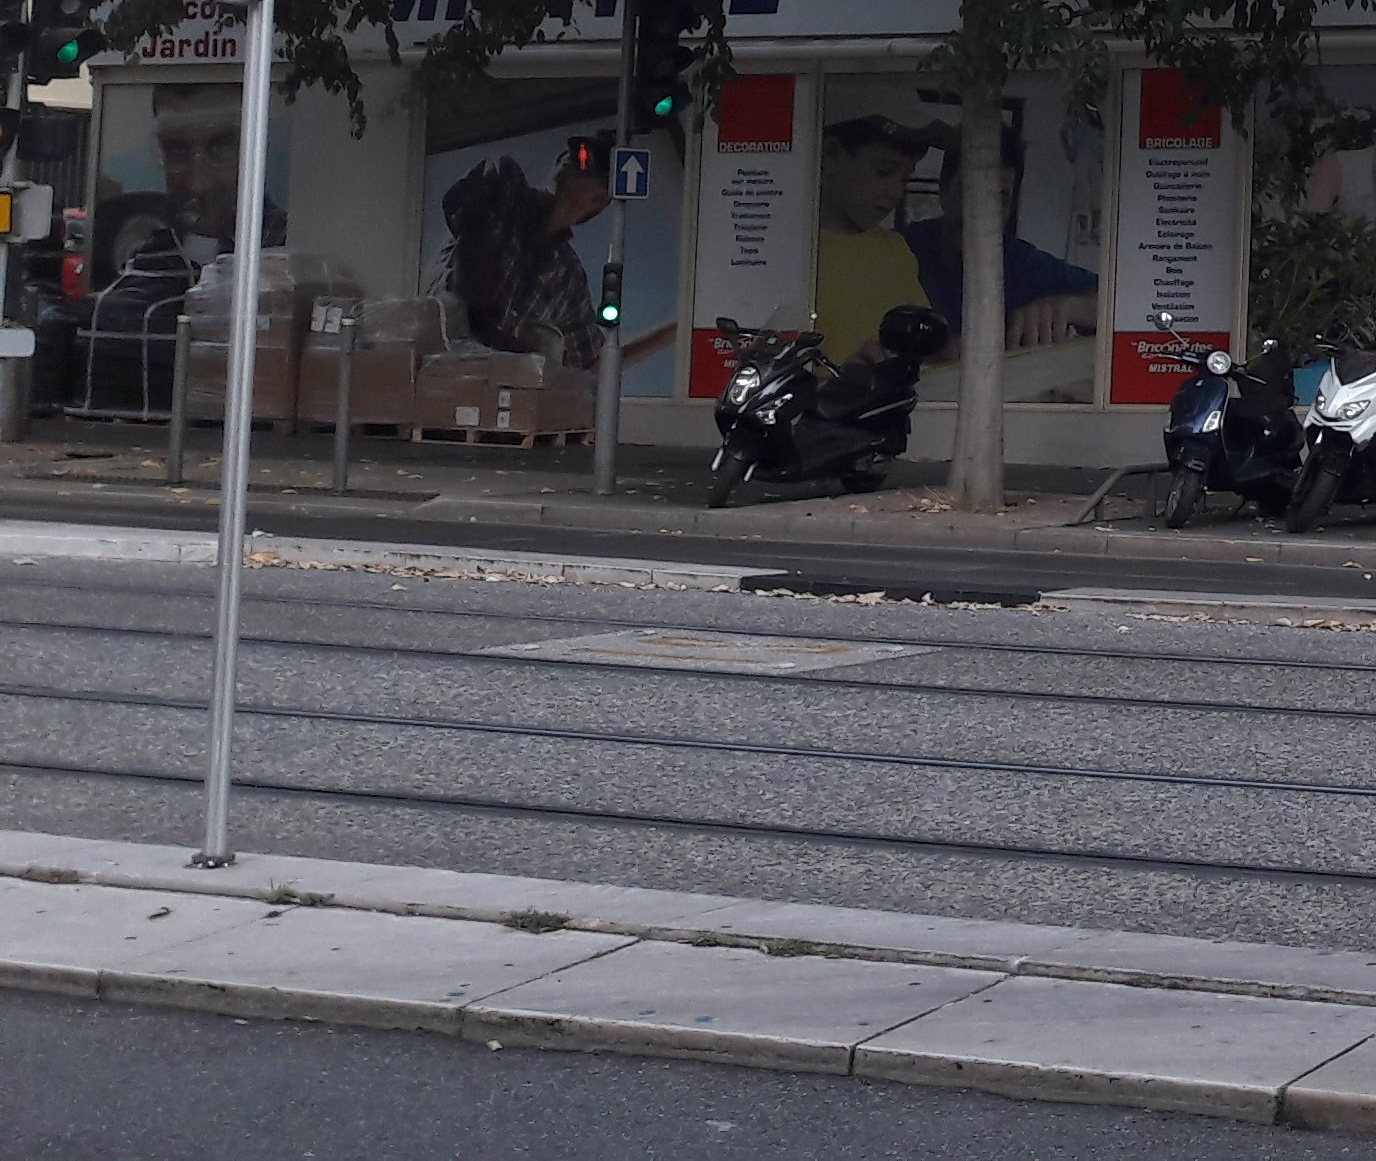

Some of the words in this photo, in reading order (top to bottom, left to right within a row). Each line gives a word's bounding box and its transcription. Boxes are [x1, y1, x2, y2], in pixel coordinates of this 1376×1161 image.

[141, 30, 237, 59] Jardin
[1145, 137, 1214, 149] BRICOLAGE
[1148, 363, 1194, 374] MISTRAL
